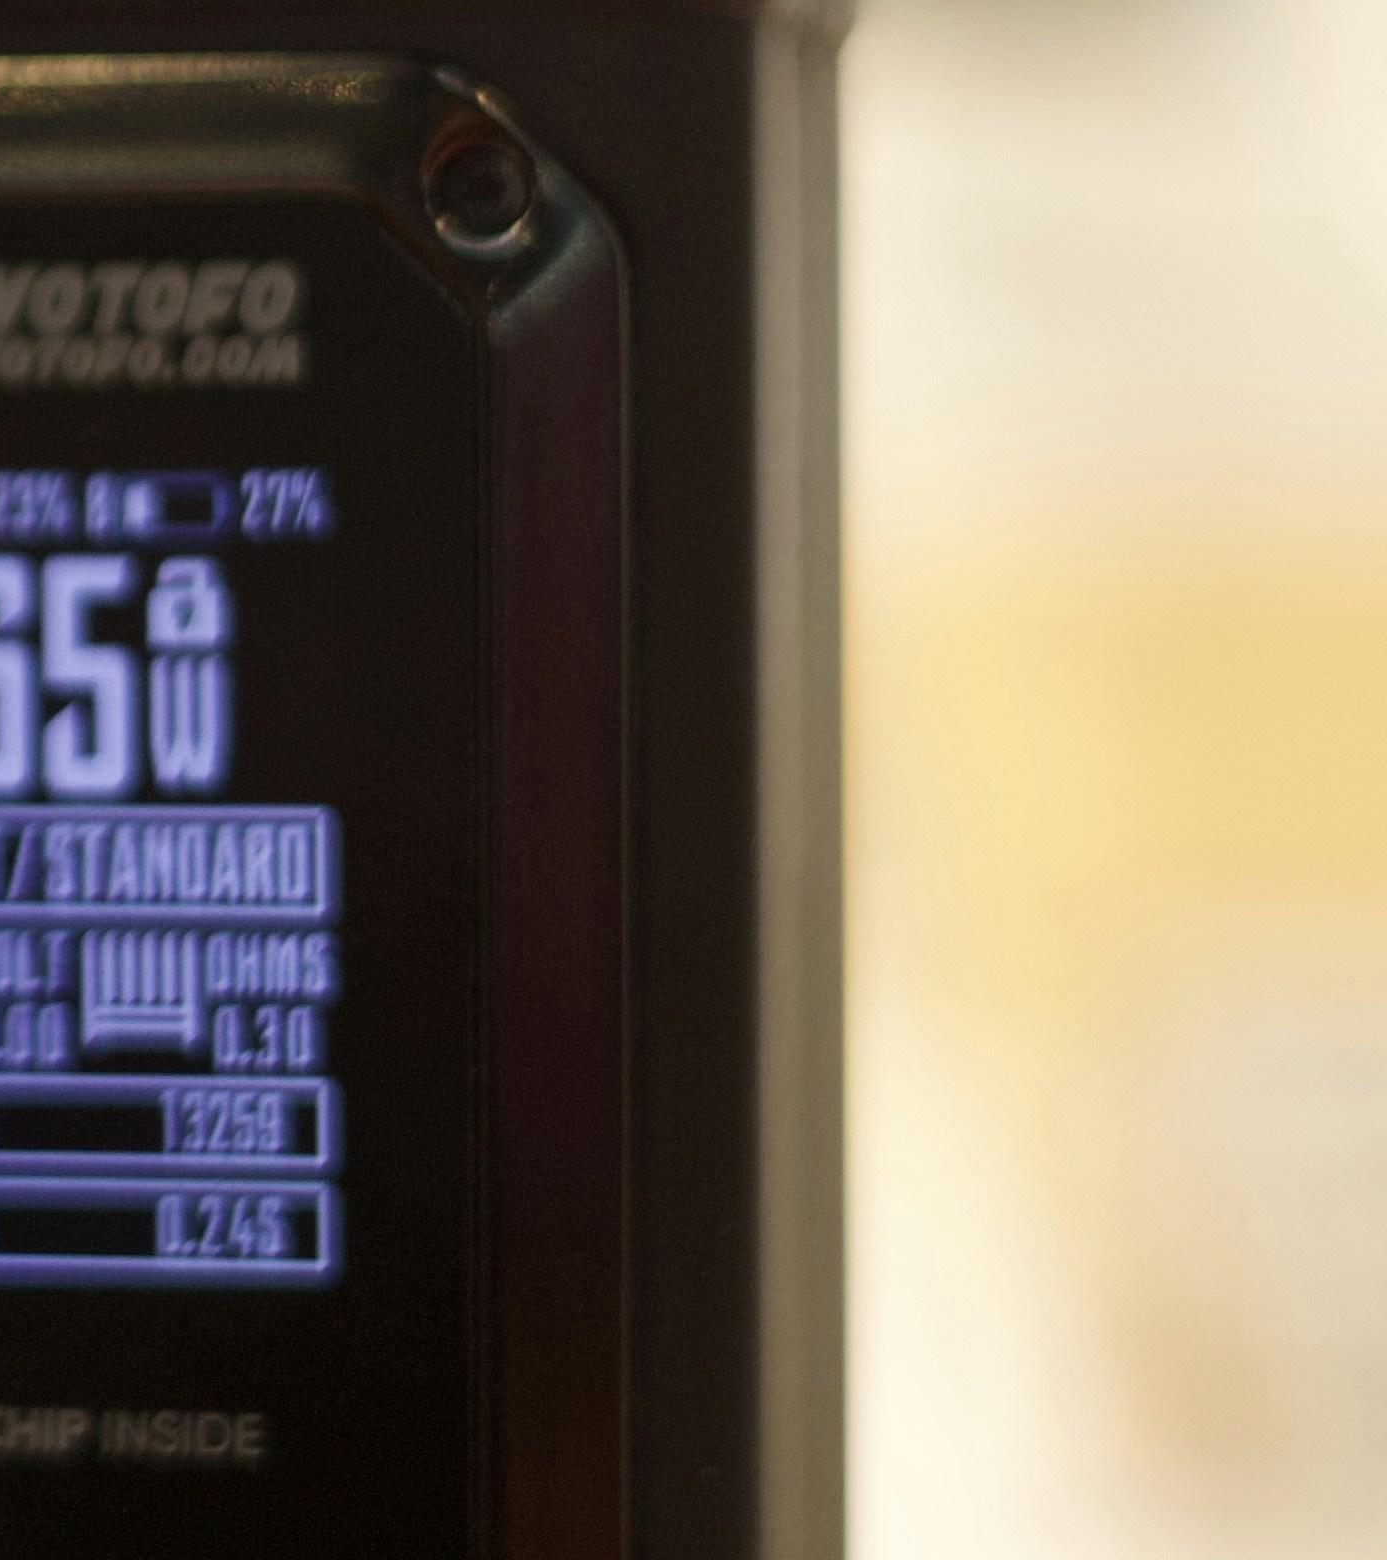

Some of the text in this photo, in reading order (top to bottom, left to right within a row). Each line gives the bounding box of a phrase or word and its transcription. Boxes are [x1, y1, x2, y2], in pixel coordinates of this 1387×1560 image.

[239, 466, 331, 538] 27%
[205, 930, 337, 1000] OHMS
[214, 1002, 317, 1072] 0.30
[157, 1088, 289, 1154] 13259
[99, 1410, 265, 1457] INSIDE
